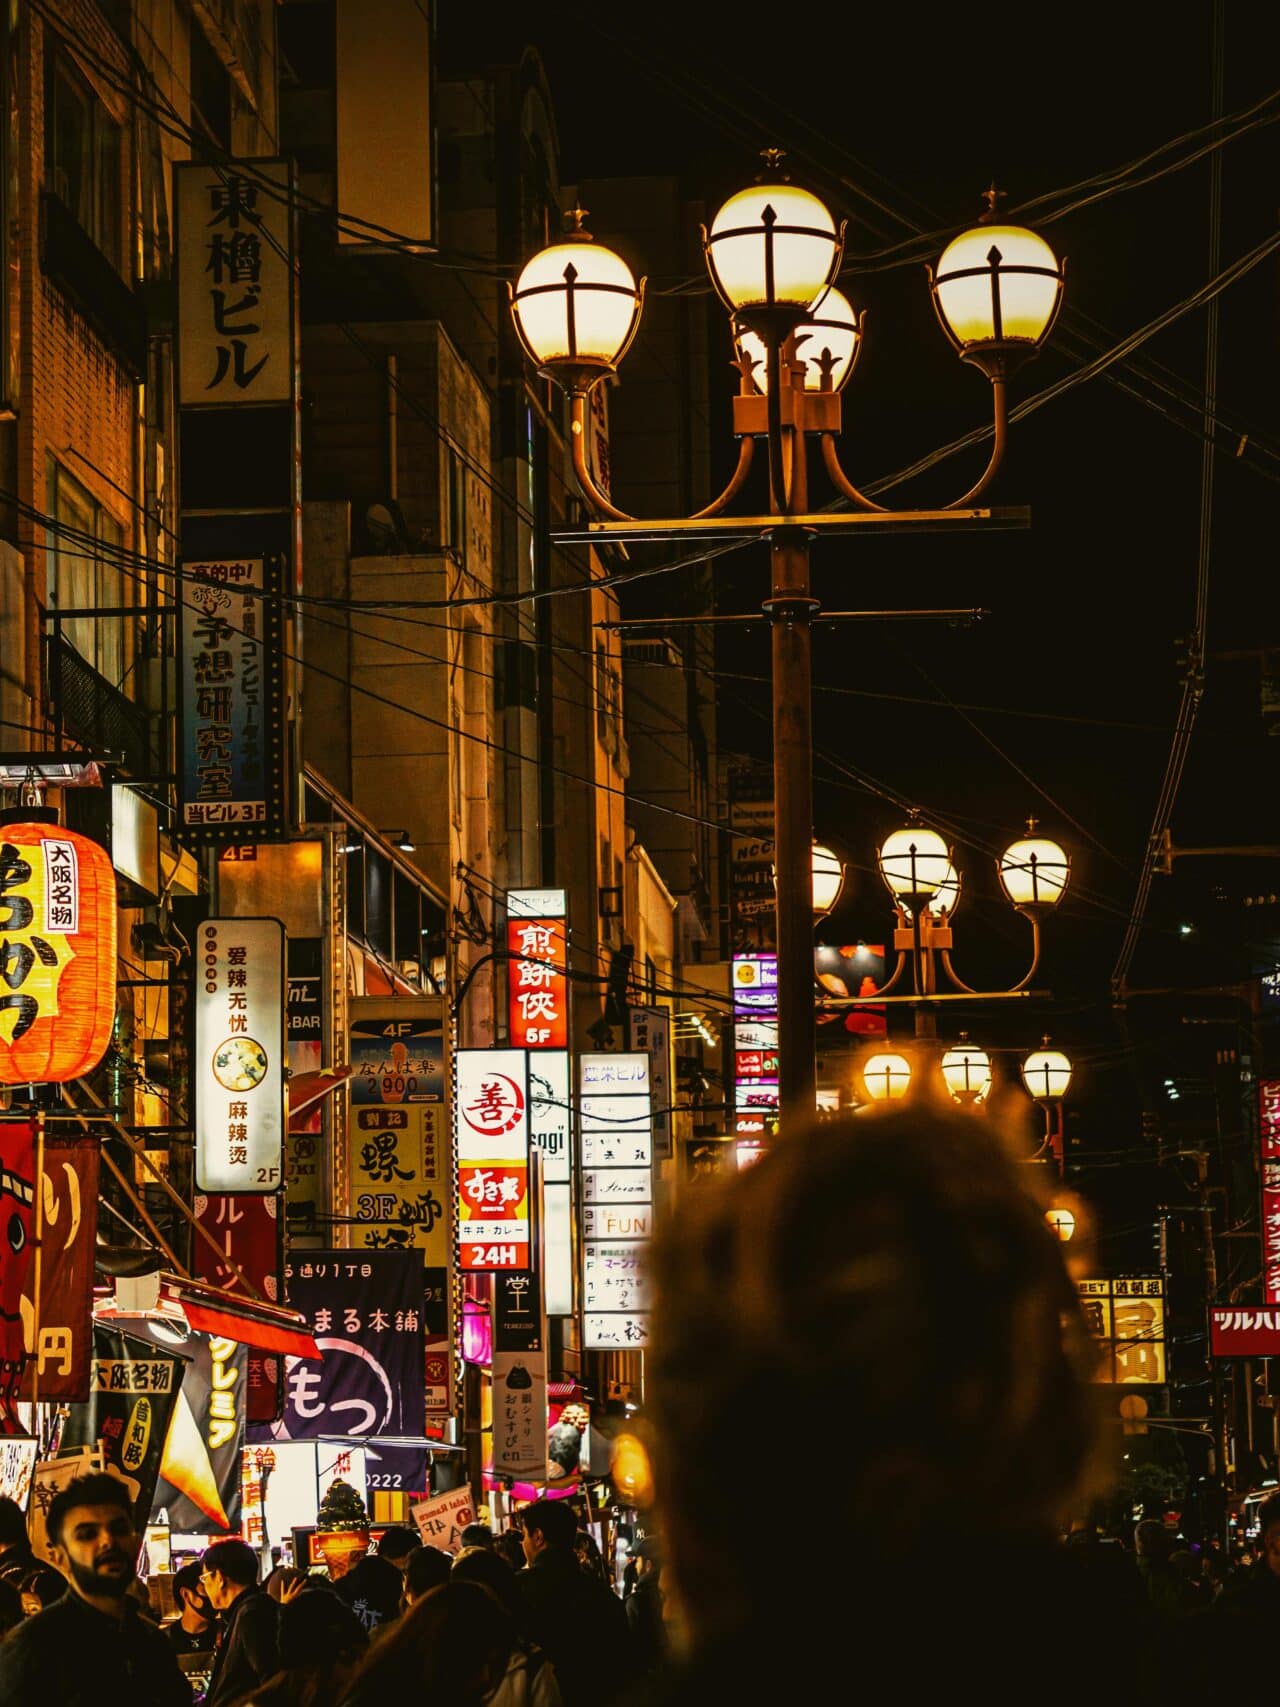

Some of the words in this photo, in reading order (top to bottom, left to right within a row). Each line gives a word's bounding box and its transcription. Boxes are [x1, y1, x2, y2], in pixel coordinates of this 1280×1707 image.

[187, 805, 237, 824] 当ビル
[243, 804, 265, 821] 3F
[223, 845, 255, 861] 4F
[49, 845, 73, 926] 大阪名物
[227, 946, 249, 1034] 爱辣无忧
[382, 1022, 413, 1038] 4F
[526, 1027, 552, 1044] 5F
[466, 1082, 515, 1123] 善
[227, 1100, 250, 1166] 麻辣烫
[256, 1167, 280, 1184] 2F
[464, 1169, 521, 1206] すき家
[357, 1192, 397, 1221] 3F
[607, 1218, 647, 1234] FUN
[472, 1246, 518, 1266] 24H
[91, 1362, 171, 1391] 大阪名物
[289, 1366, 378, 1436] もつ
[504, 1392, 518, 1449] おむすび
[502, 1450, 520, 1463] en
